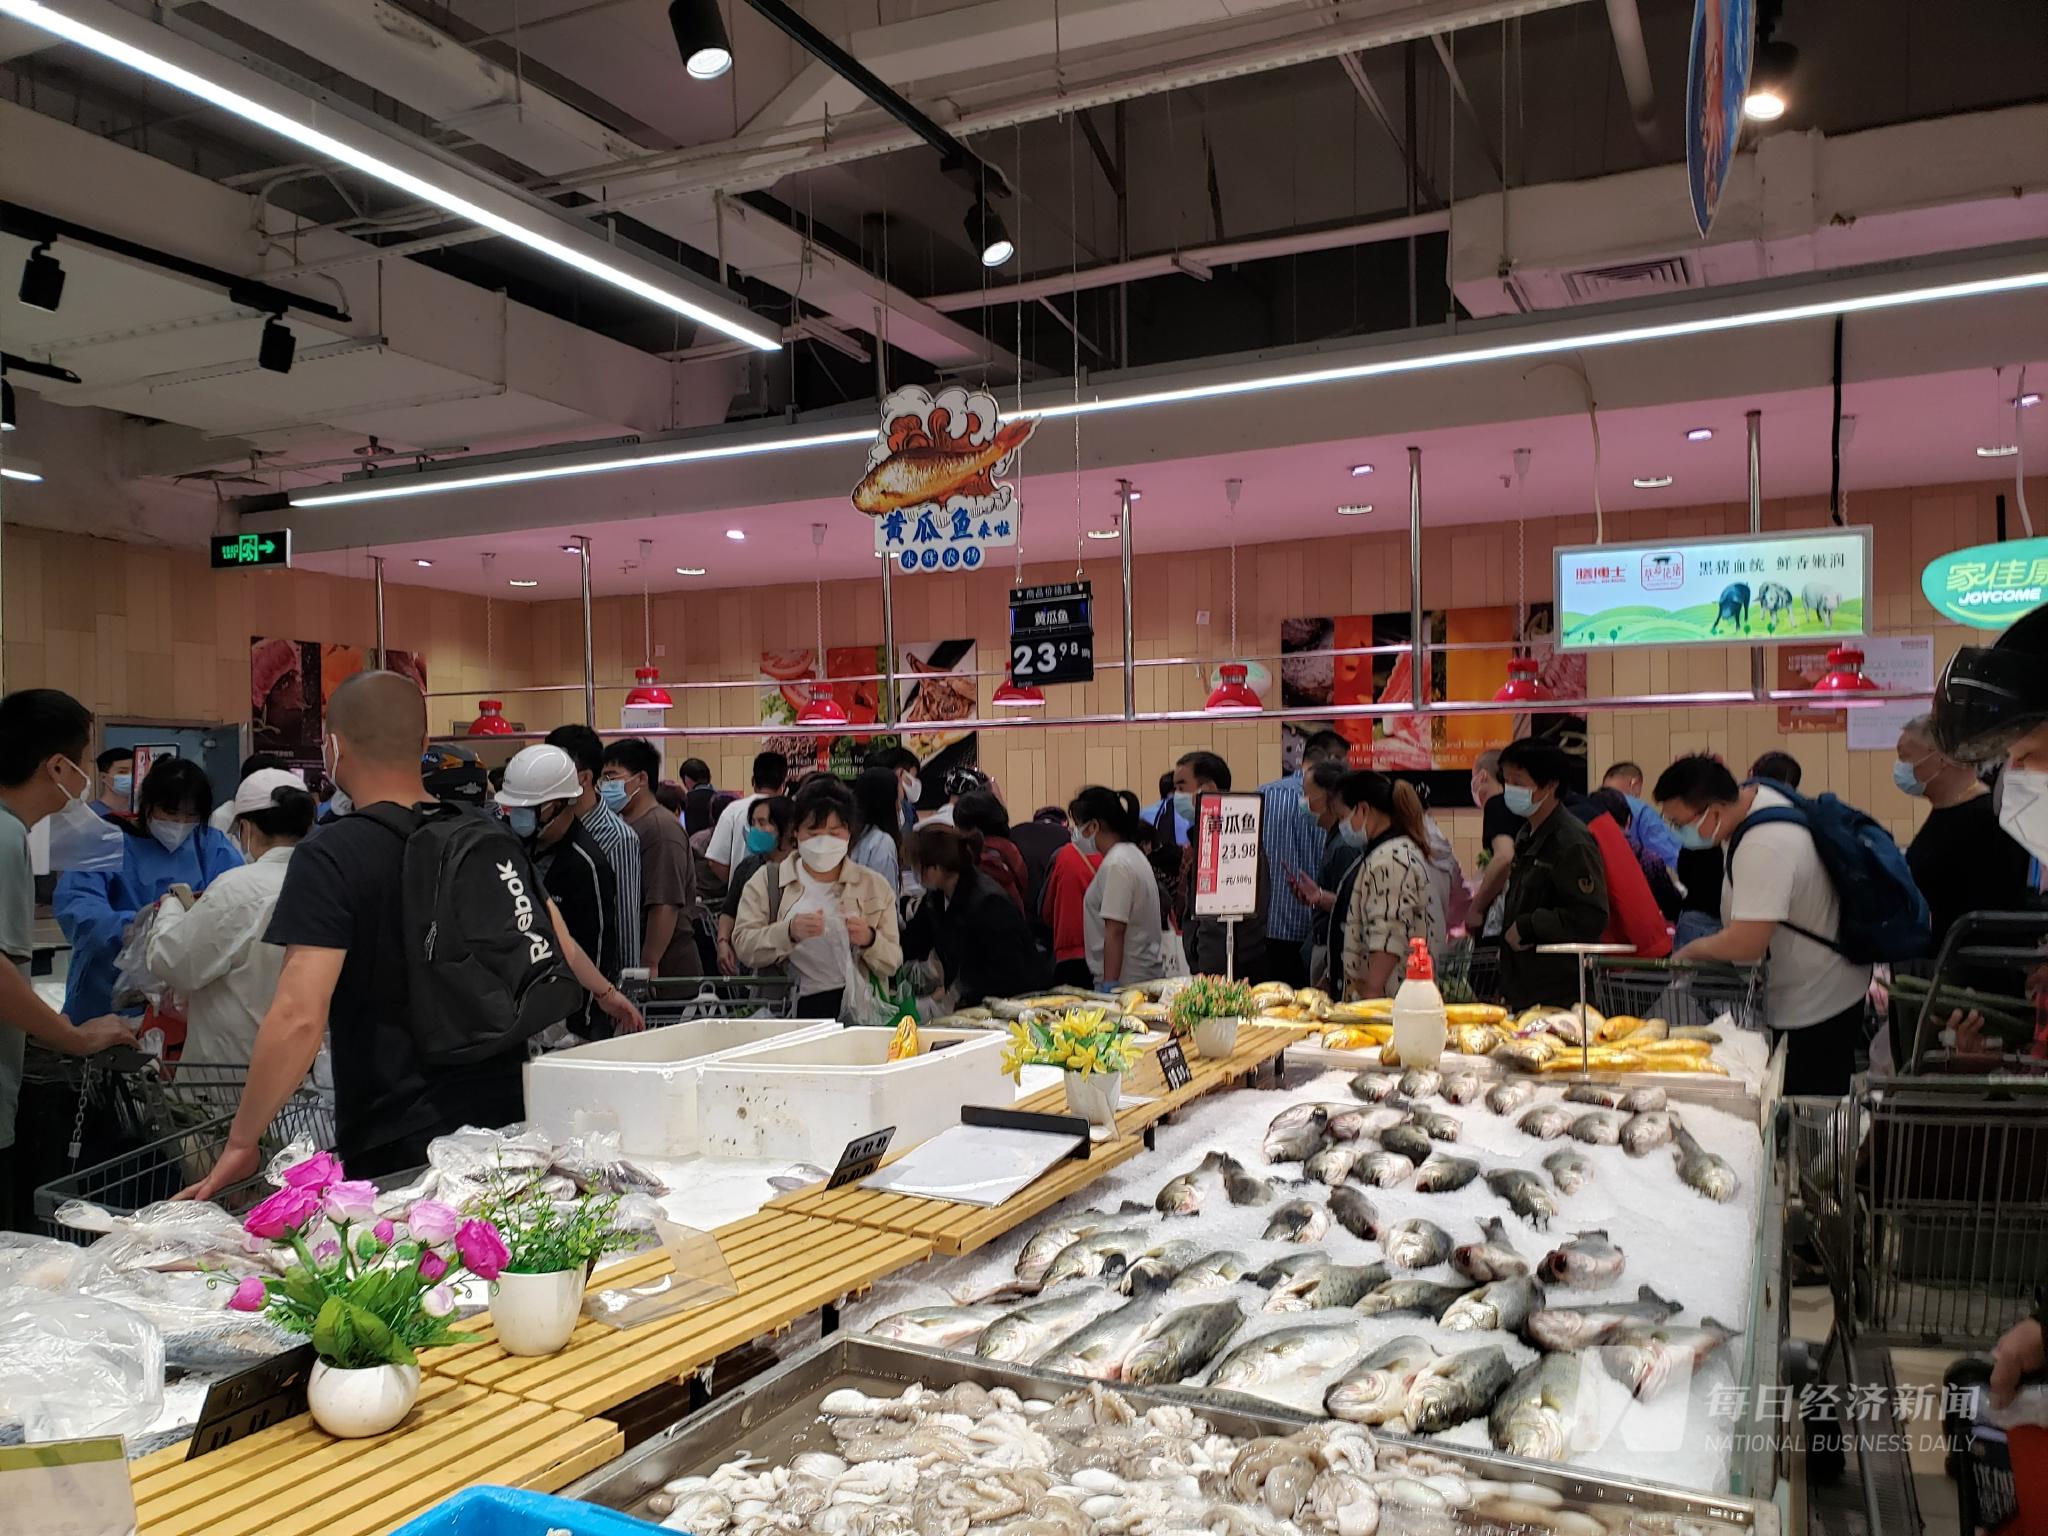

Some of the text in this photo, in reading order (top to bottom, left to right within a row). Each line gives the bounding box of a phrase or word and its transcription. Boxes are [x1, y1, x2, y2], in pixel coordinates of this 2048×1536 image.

[1958, 587, 2042, 606] JOYCOME
[1034, 609, 1070, 626] 黄瓜鱼
[854, 753, 864, 765] fro
[1208, 813, 1256, 835] 黄瓜鱼
[1222, 844, 1256, 860] 23.98
